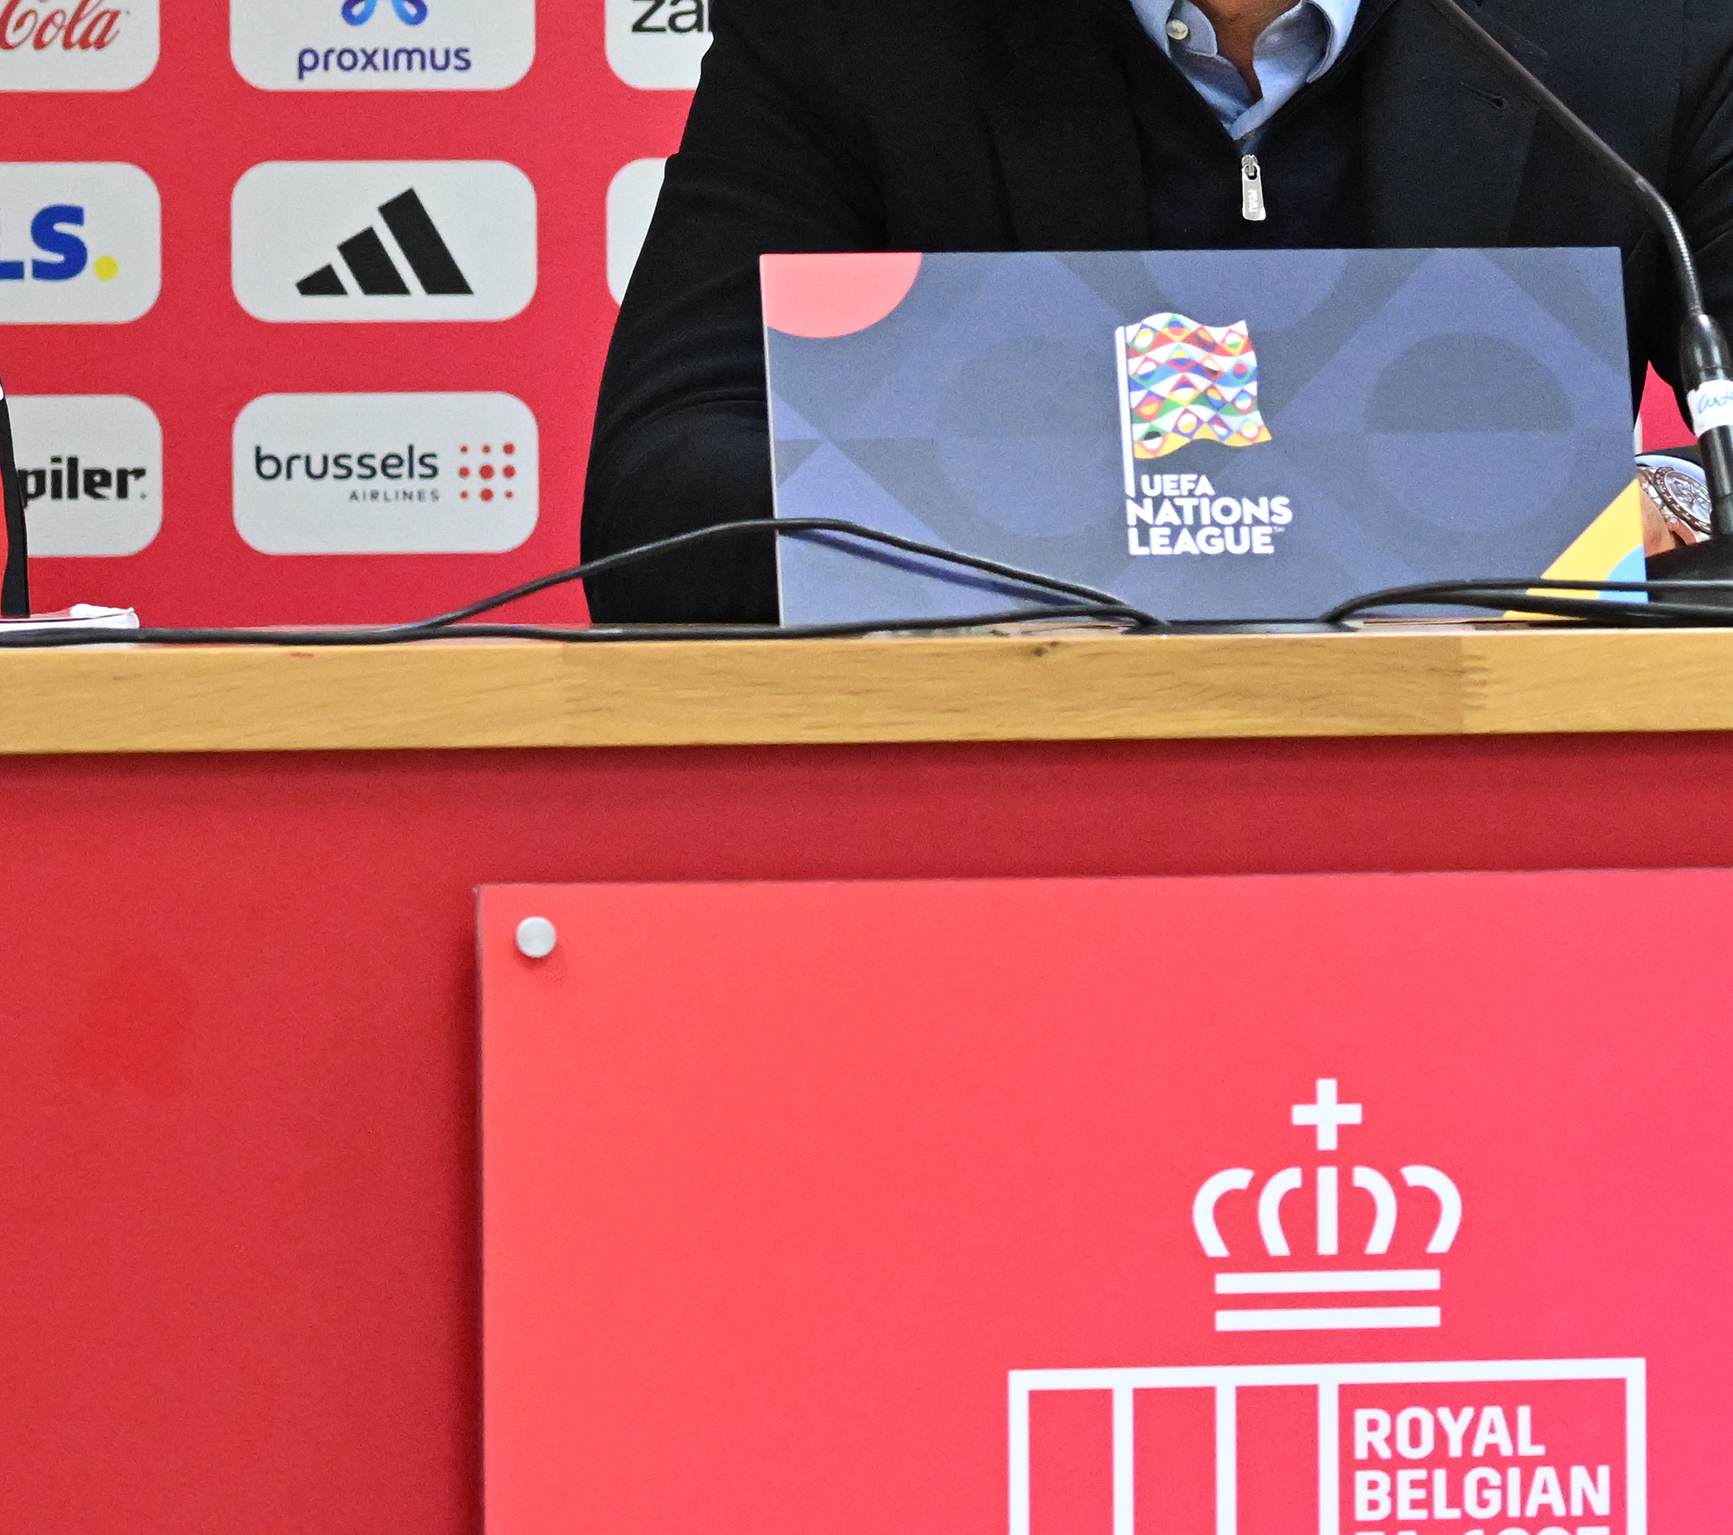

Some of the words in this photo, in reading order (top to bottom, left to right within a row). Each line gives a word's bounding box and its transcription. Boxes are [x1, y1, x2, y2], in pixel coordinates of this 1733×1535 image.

[297, 46, 472, 81] proximus
[253, 443, 440, 482] brussels
[348, 488, 440, 503] AIRLINES
[1140, 473, 1216, 497] UEFA
[1125, 495, 1294, 526] NATIONS
[1127, 526, 1276, 556] LEAGUE
[1353, 1405, 1547, 1460] ROYAL
[1353, 1464, 1611, 1522] BELGIAN
